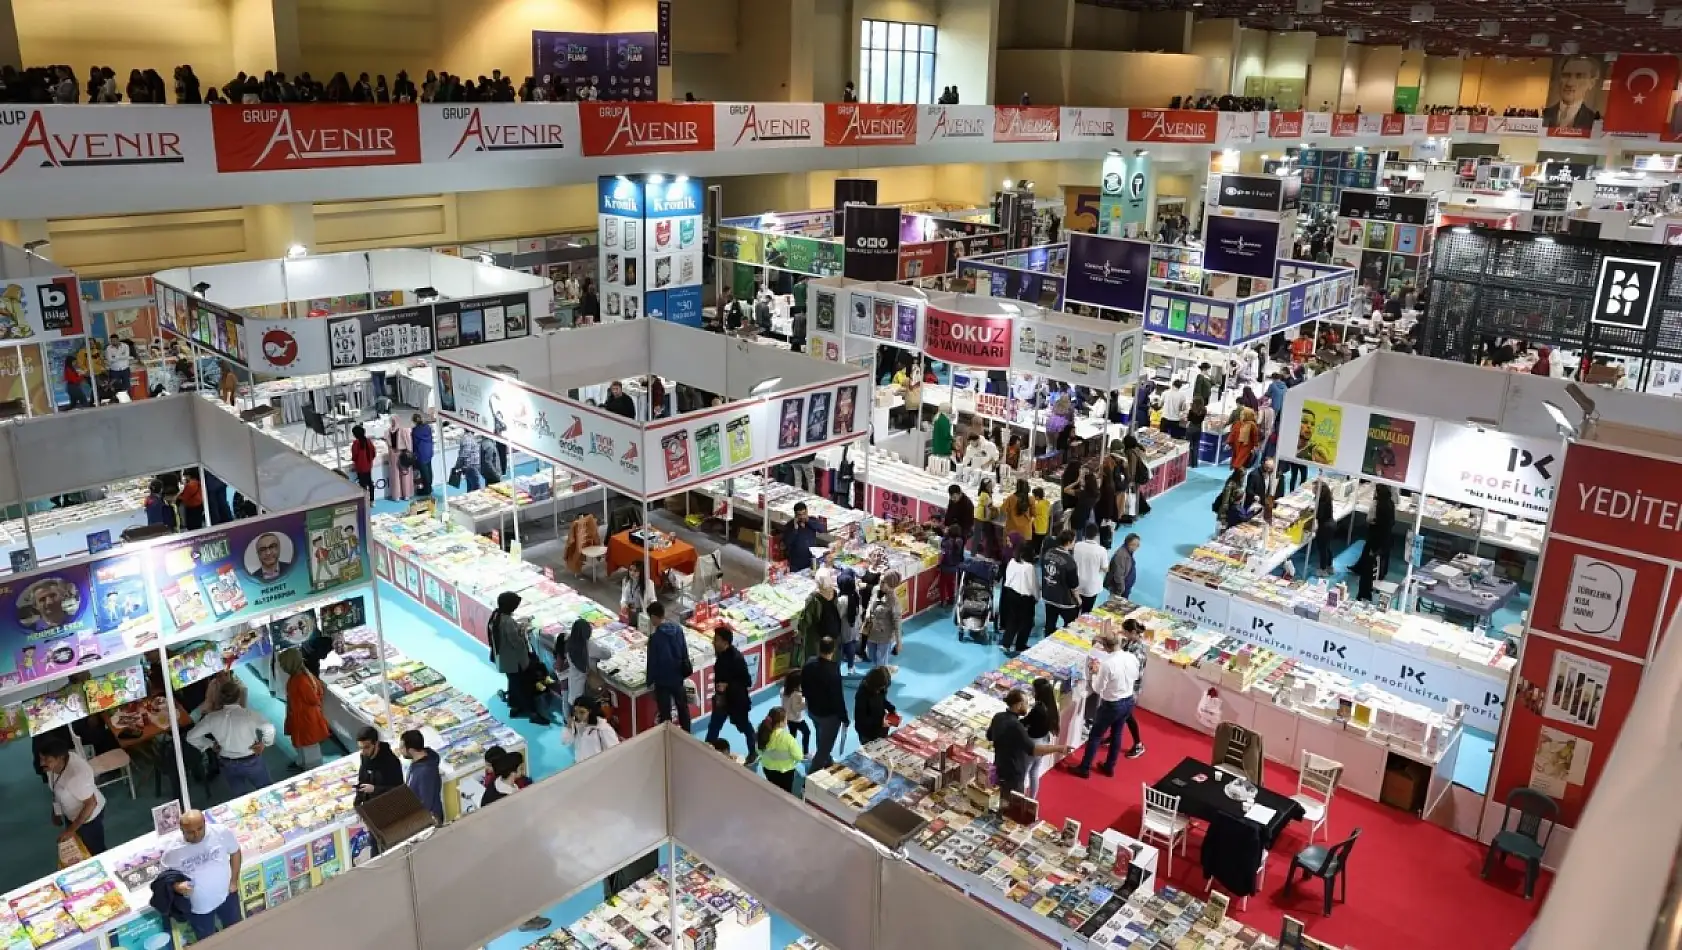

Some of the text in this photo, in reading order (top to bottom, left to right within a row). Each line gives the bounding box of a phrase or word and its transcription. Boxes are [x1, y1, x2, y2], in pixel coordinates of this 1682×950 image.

[243, 109, 278, 124] GRUP
[443, 107, 470, 120] GRUP
[600, 107, 623, 118] GRUP
[840, 105, 907, 144] AVENIR
[448, 108, 563, 159] AVENIR
[604, 107, 699, 153] AVENIR
[735, 104, 811, 146] AVENIR
[1142, 112, 1206, 140] AVENIR
[0, 110, 181, 173] AVENIR
[252, 108, 394, 168] AVENIR
[604, 195, 638, 211] Kronik
[653, 196, 696, 211] Kronik
[1613, 269, 1640, 287] PA
[1610, 284, 1640, 301] RO
[941, 320, 1004, 344] DOKUZ
[939, 338, 1004, 358] YAYINLARI
[1368, 428, 1410, 446] RONALDO
[261, 582, 287, 594] MEHMET
[1165, 604, 1225, 628] PROFİLKİTAP
[1229, 626, 1293, 651] PROFİLKİTAP
[1300, 649, 1367, 676] PROFİLKİTAP
[1374, 675, 1448, 703] PROFİLKİTAP
